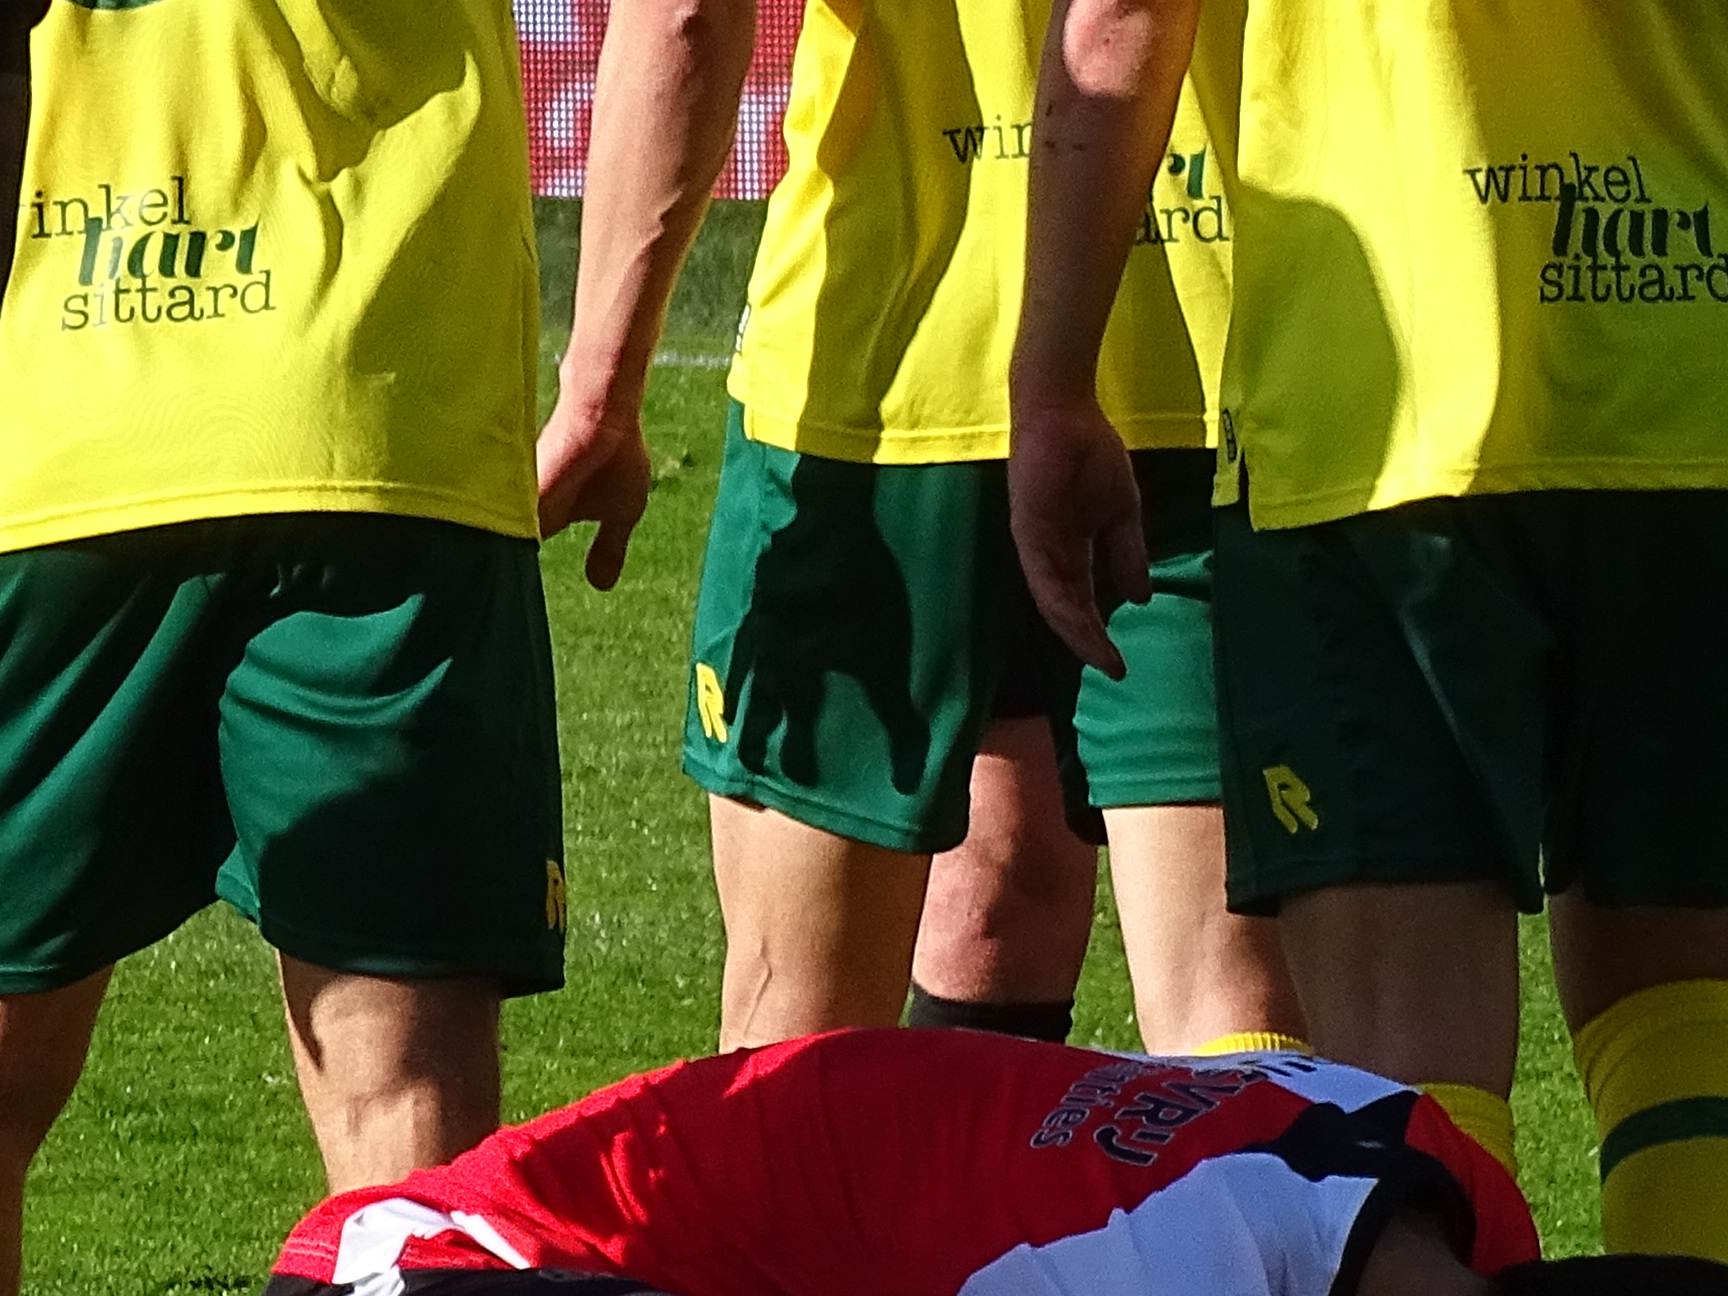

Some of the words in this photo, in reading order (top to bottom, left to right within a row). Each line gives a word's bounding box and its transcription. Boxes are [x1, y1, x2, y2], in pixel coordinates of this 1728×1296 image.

[29, 175, 192, 240] inkel
[1462, 150, 1653, 206] winkel
[60, 269, 277, 332] sittard
